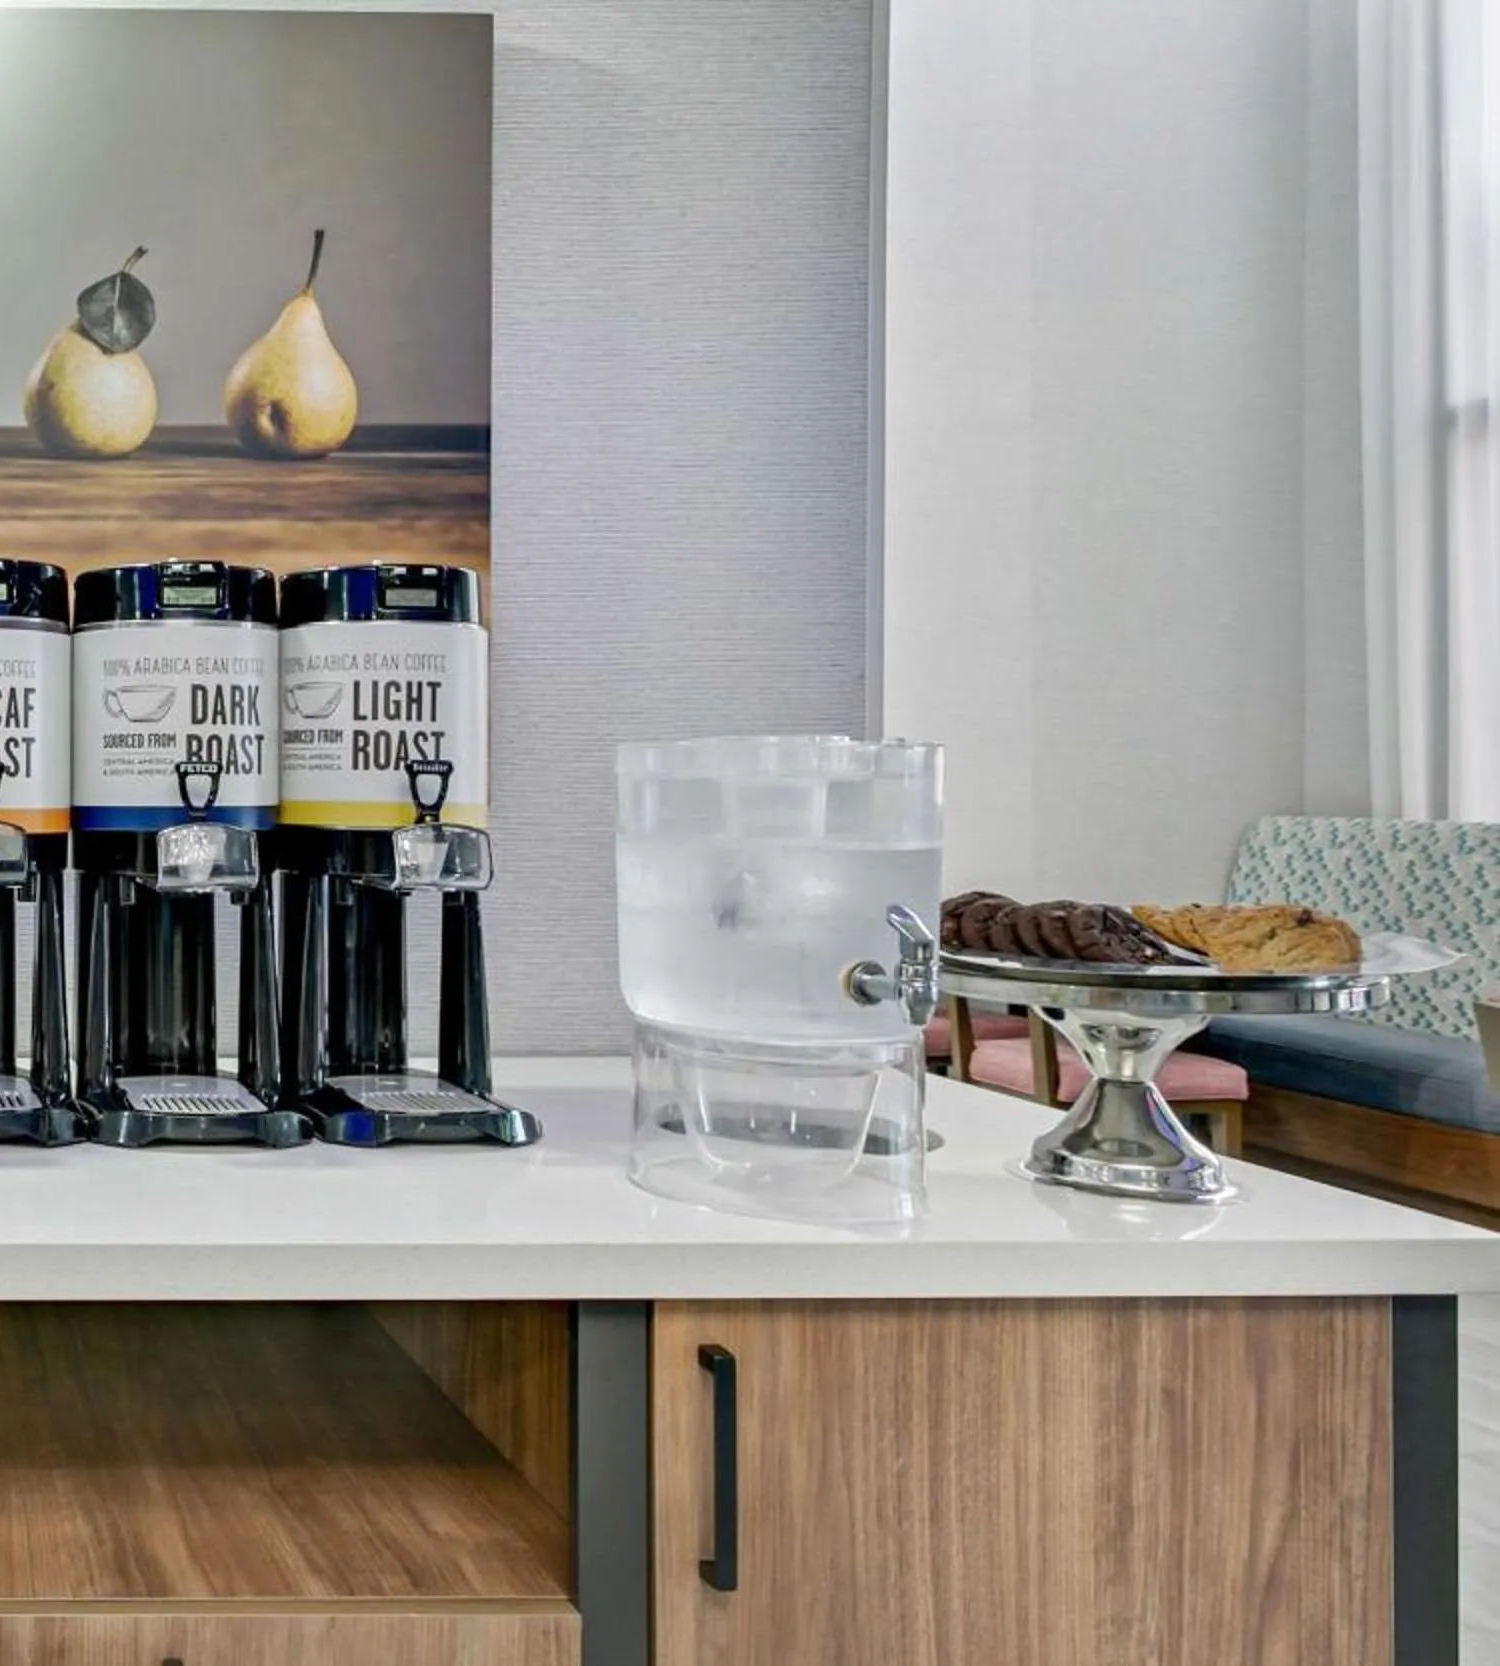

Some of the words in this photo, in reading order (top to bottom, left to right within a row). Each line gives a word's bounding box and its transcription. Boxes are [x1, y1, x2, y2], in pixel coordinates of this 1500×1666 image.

[133, 657, 192, 676] ARABICA
[195, 656, 229, 675] BEAN
[306, 654, 359, 672] ARABICA
[363, 653, 400, 672] BEAN
[404, 653, 447, 673] COFFEE
[191, 684, 261, 726] DARK
[353, 680, 442, 722] LIGHT
[103, 733, 145, 749] SOURCED
[147, 733, 177, 749] FROM
[317, 729, 344, 745] FROM
[352, 730, 445, 771] ROAST
[186, 734, 265, 775] ROAST
